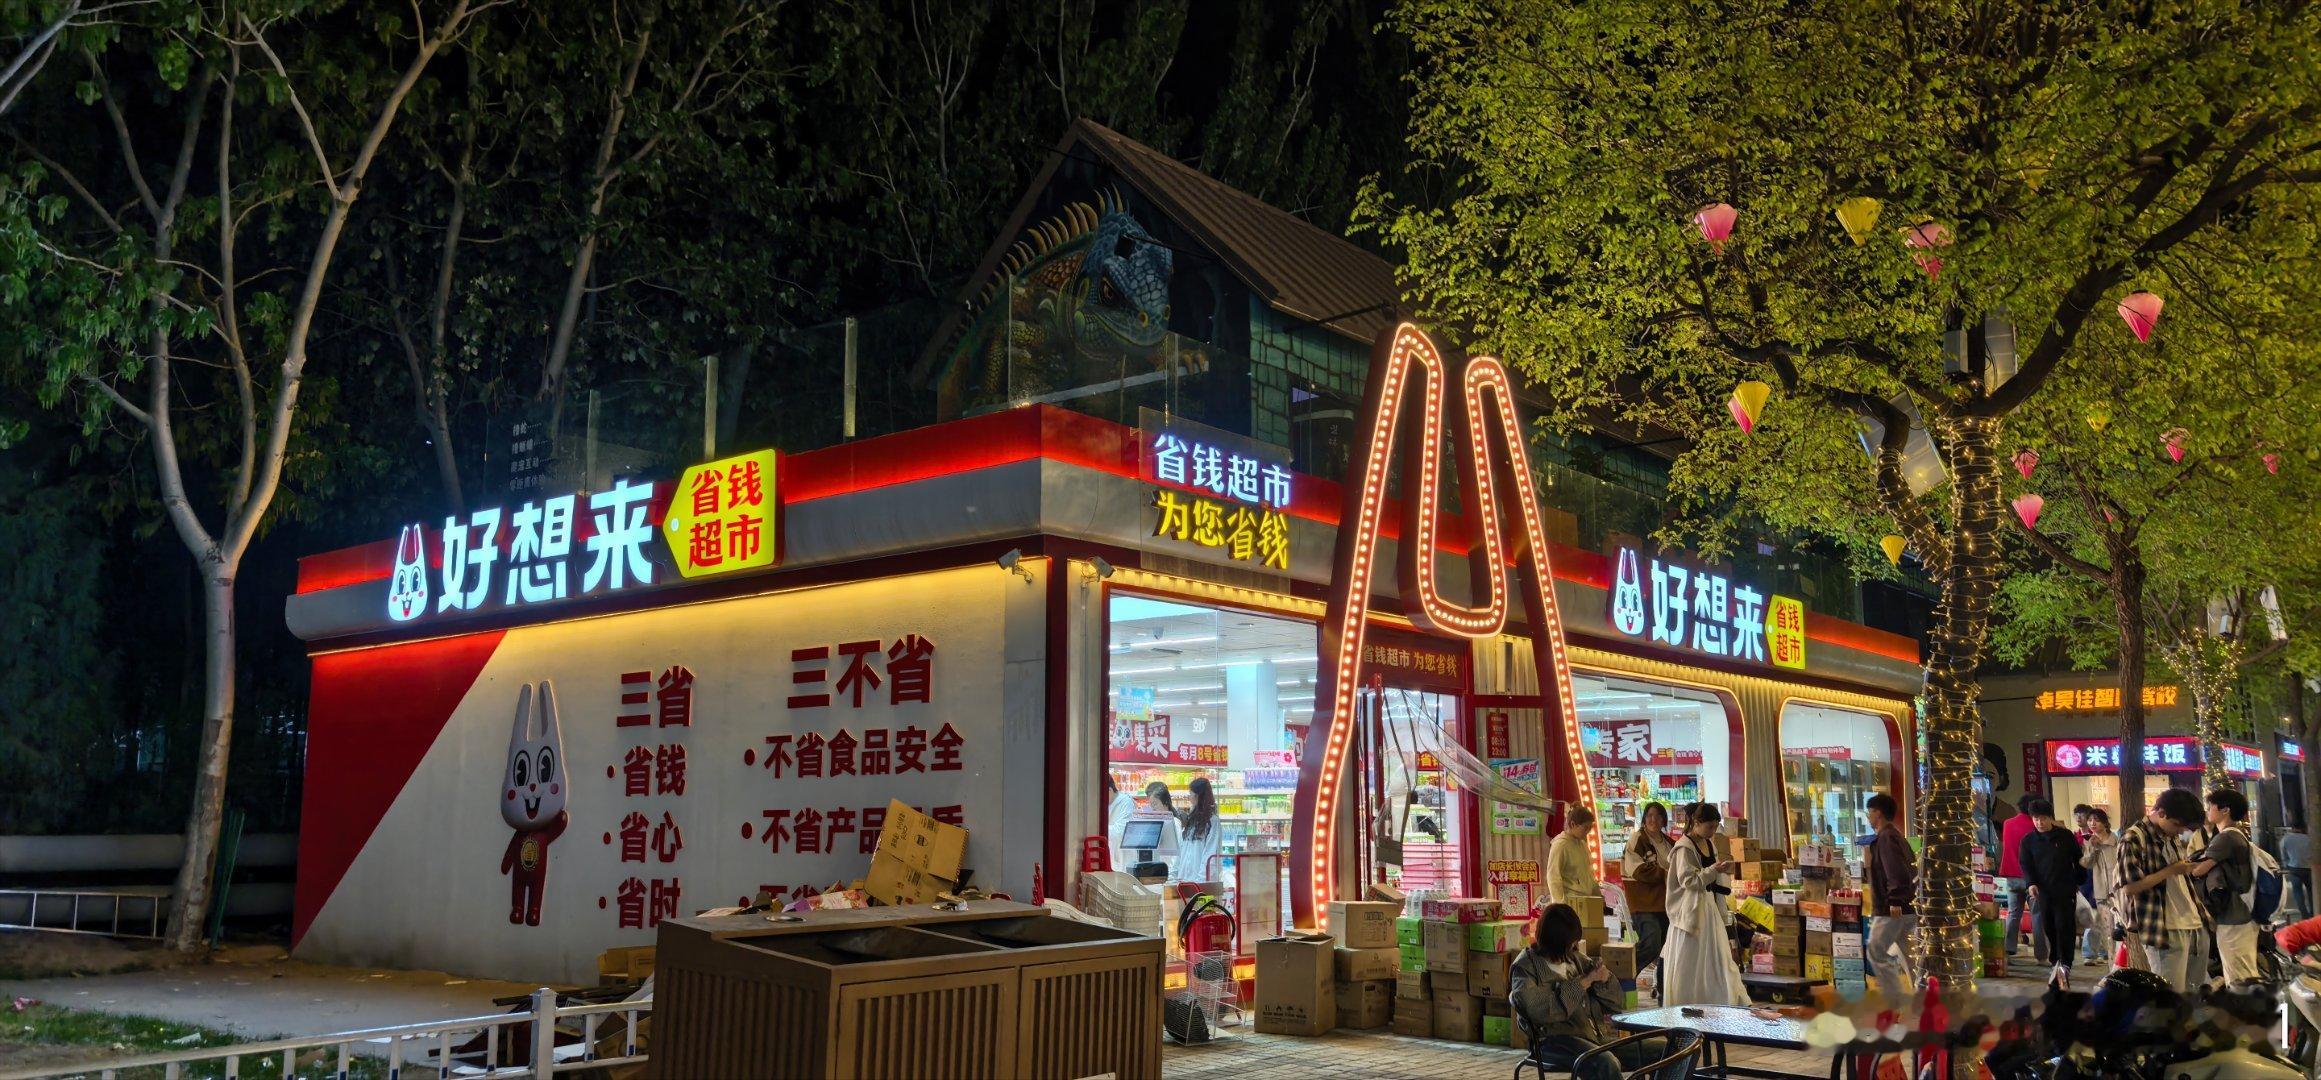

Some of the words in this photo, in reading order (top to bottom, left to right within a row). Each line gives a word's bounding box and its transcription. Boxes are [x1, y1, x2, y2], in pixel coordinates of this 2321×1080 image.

[691, 460, 764, 516] 省钱
[1154, 434, 1292, 508] 省钱超市
[437, 479, 655, 614] 好想来
[688, 515, 765, 570] 超市
[1157, 490, 1289, 569] 为您省钱
[1651, 560, 1763, 661] 好想来
[1776, 600, 1800, 633] 省钱
[787, 634, 935, 709] 三不省
[1363, 645, 1410, 668] 省钱超市
[1413, 651, 1457, 678] 为您省钱
[1776, 633, 1800, 664] 超市
[616, 665, 695, 728] 三省
[623, 744, 688, 797] 省钱
[764, 723, 964, 779] 不省食品安全
[620, 811, 684, 863] 省心
[617, 877, 681, 929] 省时
